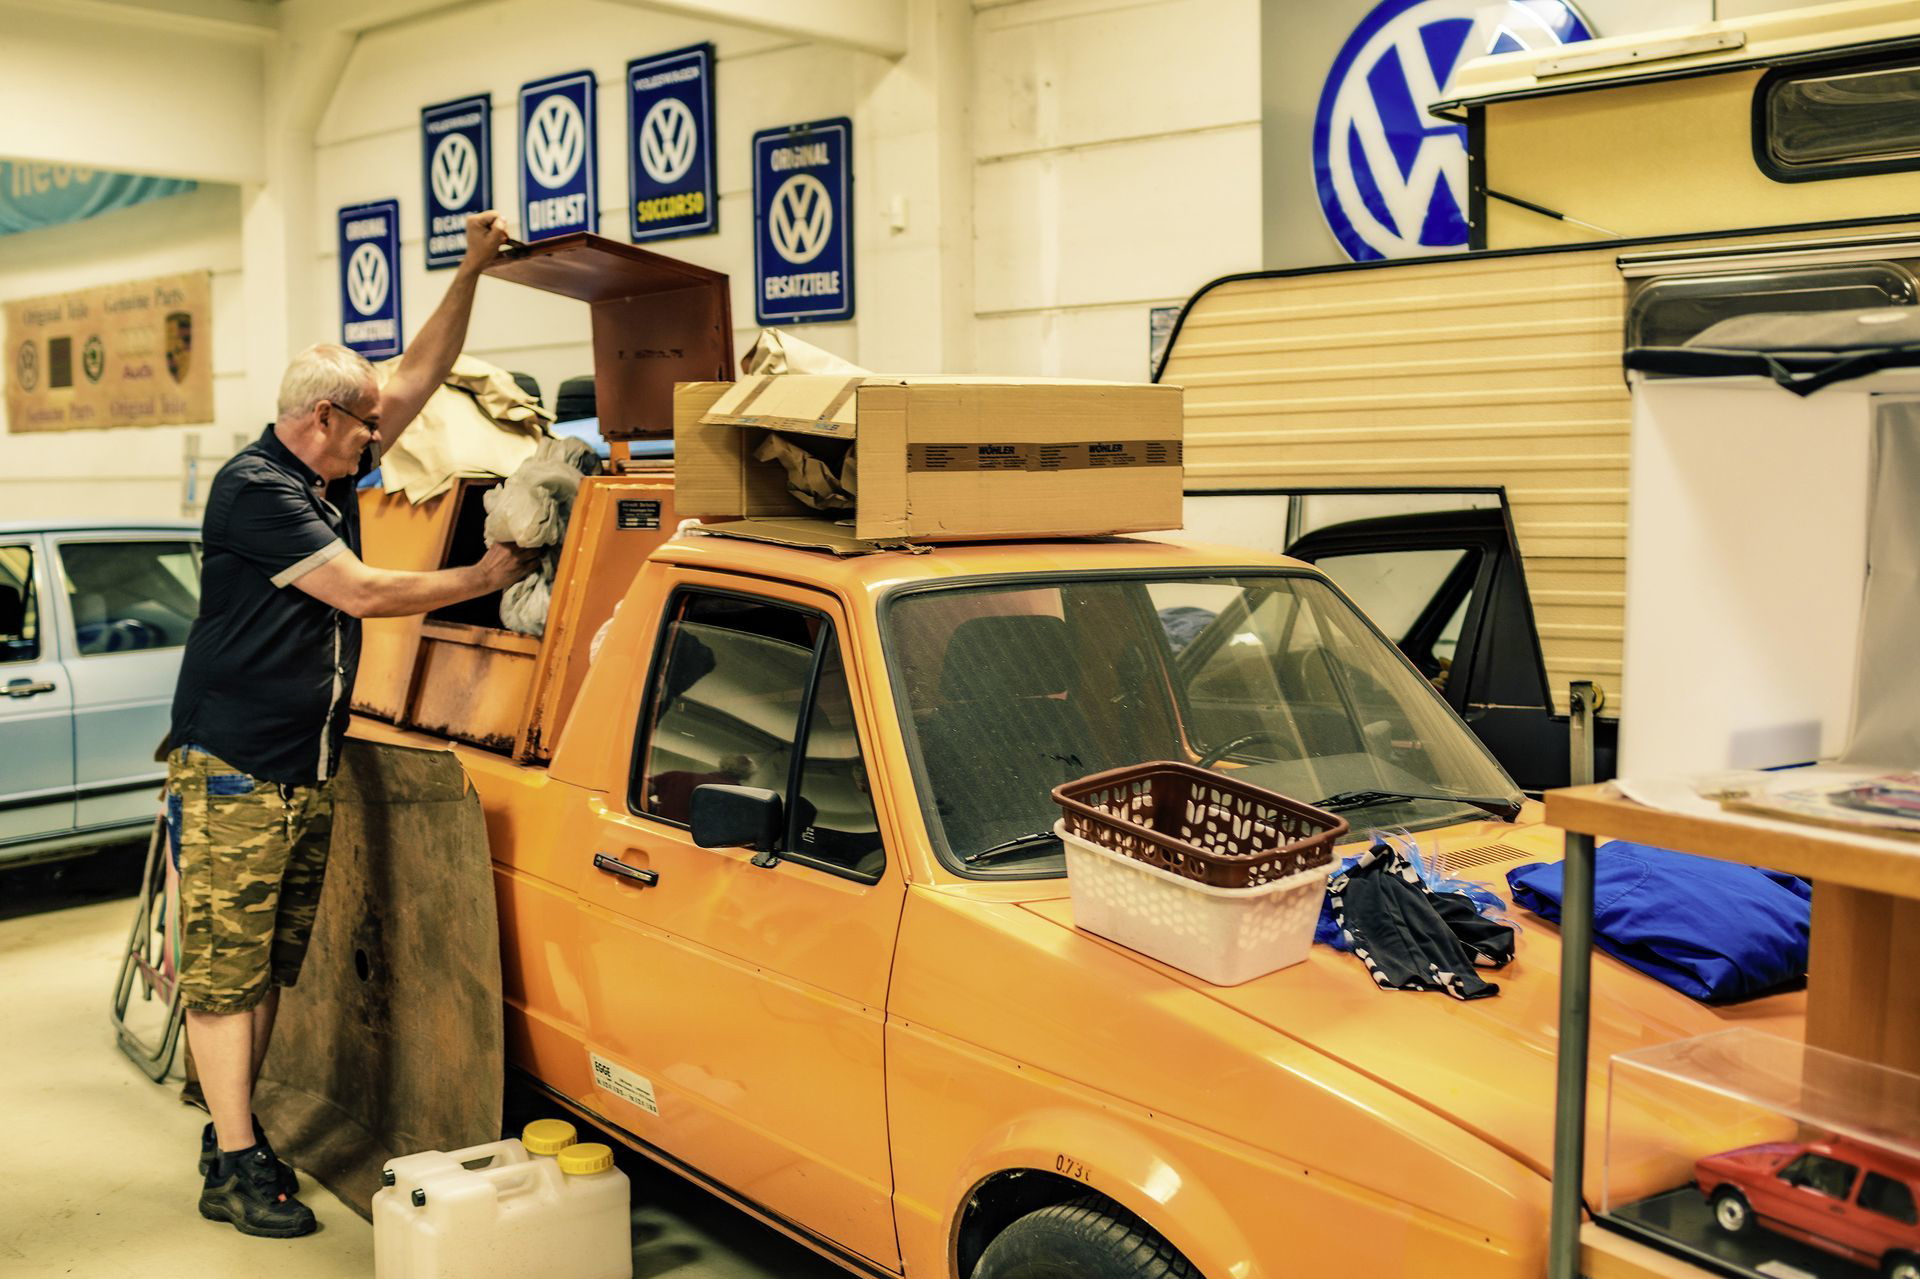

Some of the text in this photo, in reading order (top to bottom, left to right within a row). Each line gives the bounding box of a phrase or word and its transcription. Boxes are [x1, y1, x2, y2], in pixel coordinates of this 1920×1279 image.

[771, 142, 830, 172] ORIGINAL
[528, 192, 587, 232] DIENST
[638, 191, 704, 223] SOCCORSO
[765, 270, 840, 300] ERSATZTEILE
[978, 444, 1015, 455] WÖHLER
[1088, 442, 1123, 453] WÖHLER
